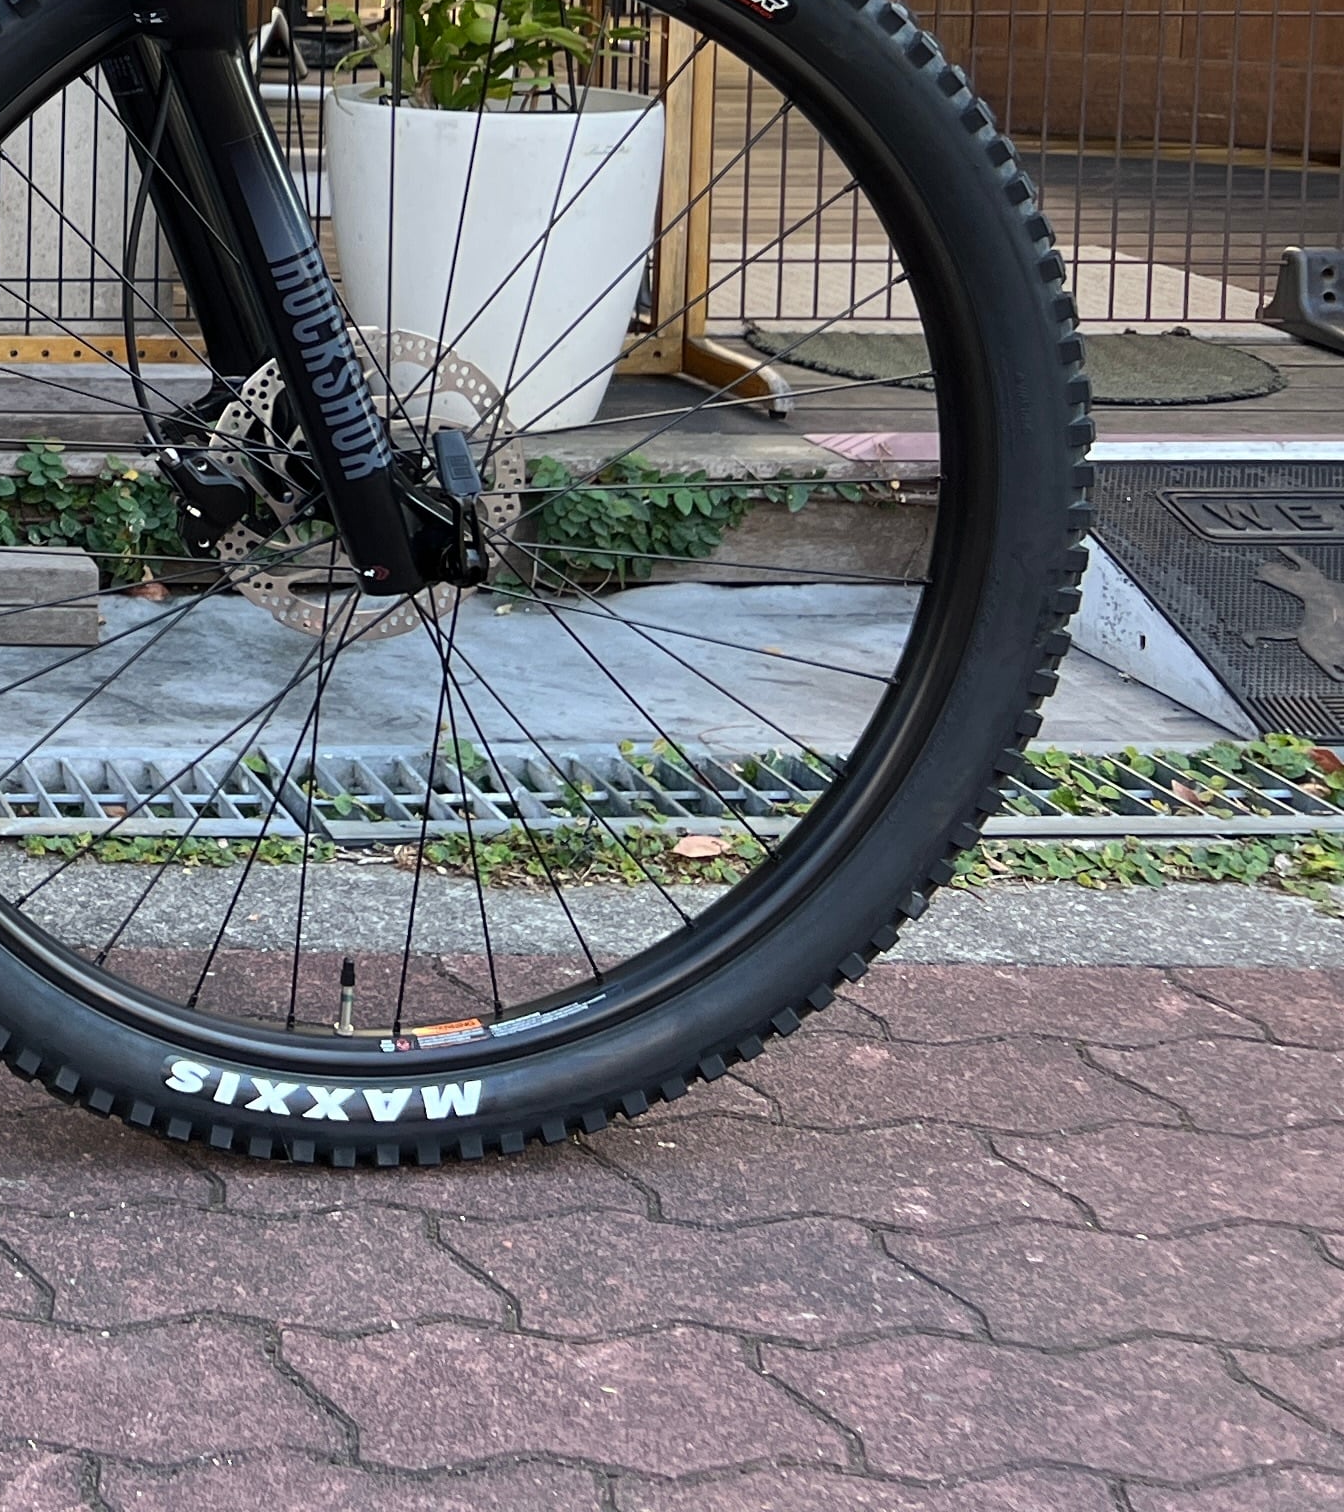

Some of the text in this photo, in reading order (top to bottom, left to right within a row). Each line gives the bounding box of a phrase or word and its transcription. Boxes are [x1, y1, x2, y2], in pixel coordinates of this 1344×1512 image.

[271, 243, 393, 481] ROCKSHOX
[1201, 502, 1343, 532] WE
[165, 1058, 483, 1122] MAXXIS
